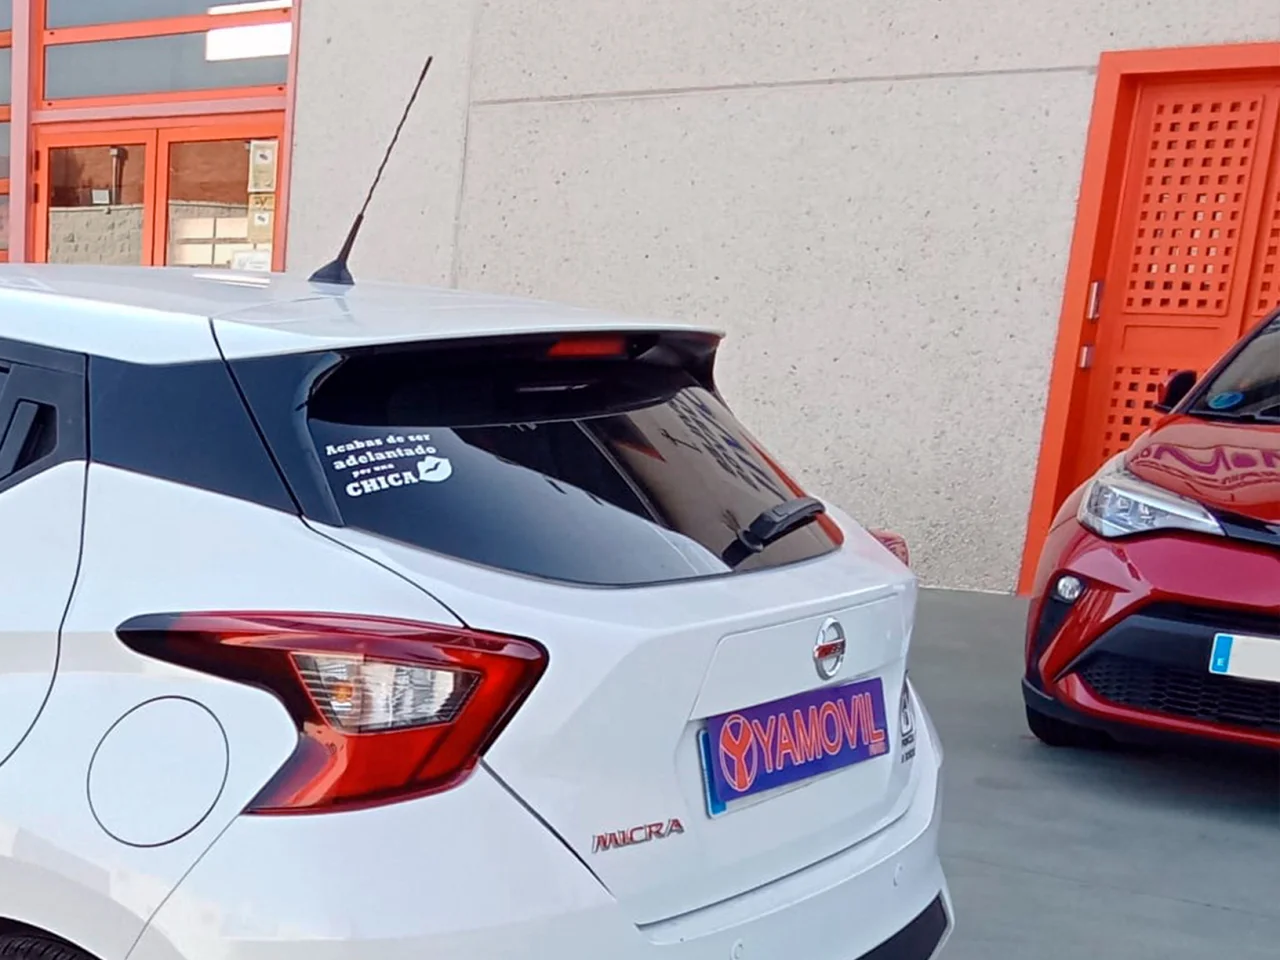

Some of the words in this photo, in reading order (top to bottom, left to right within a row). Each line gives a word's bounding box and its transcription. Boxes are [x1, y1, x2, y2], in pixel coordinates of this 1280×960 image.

[326, 438, 383, 456] Acabas
[386, 434, 405, 444] de
[408, 432, 431, 443] ser
[333, 445, 437, 470] adelantado
[352, 468, 371, 478] por
[373, 463, 395, 472] una
[346, 471, 419, 497] CHICA
[753, 692, 885, 773] YAMOVIL
[591, 817, 685, 854] MICRA
